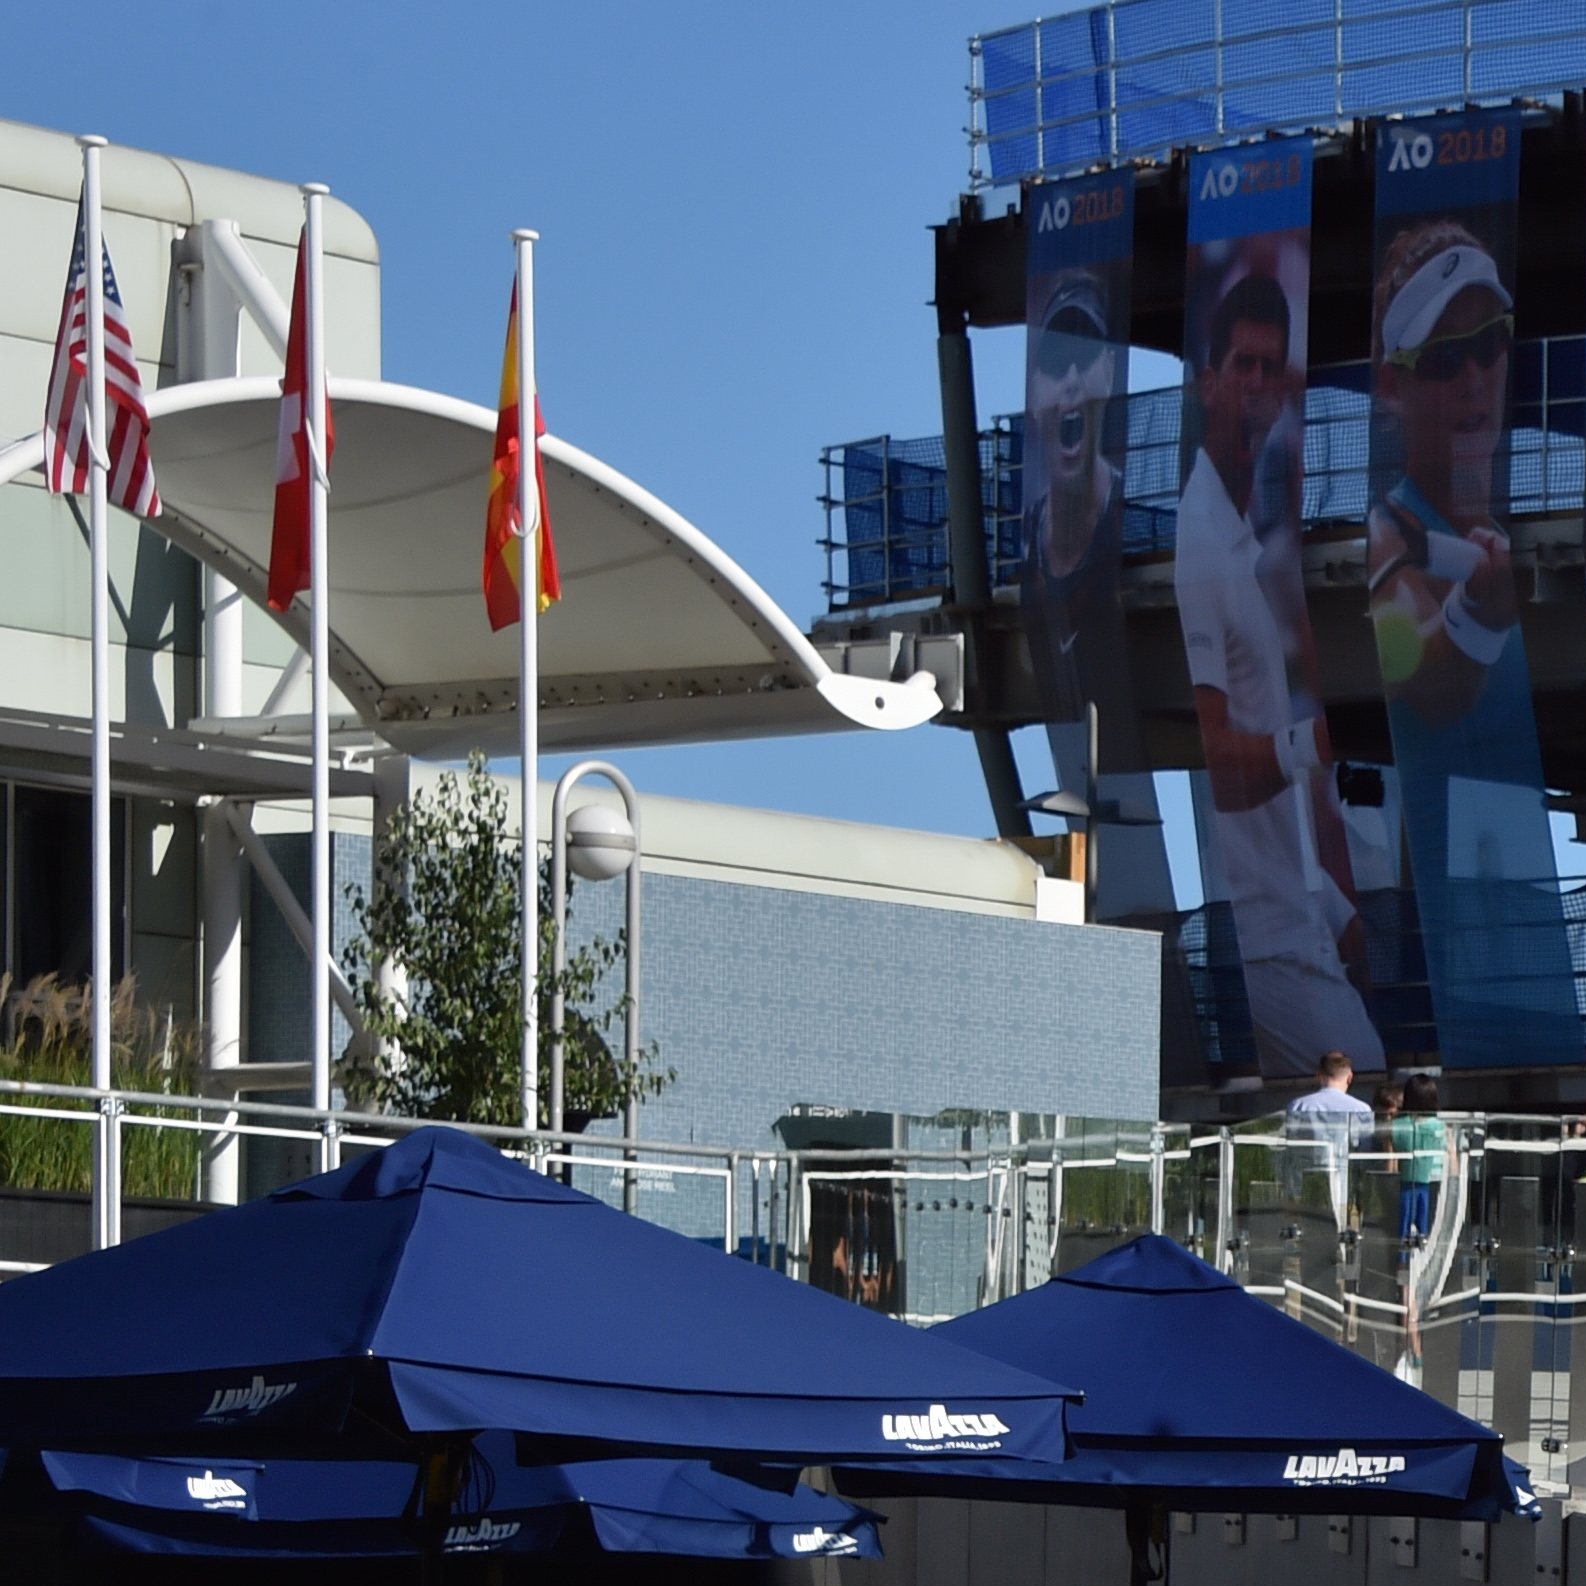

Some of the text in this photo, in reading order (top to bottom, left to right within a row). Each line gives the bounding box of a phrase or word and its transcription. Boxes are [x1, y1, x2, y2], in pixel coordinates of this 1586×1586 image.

[1388, 125, 1507, 172] AO 2018
[1200, 154, 1301, 201] AO 2018
[1038, 186, 1123, 233] AO 2018
[882, 1404, 1011, 1441] LAVAZZA
[1283, 1448, 1406, 1479] LAVAZZA
